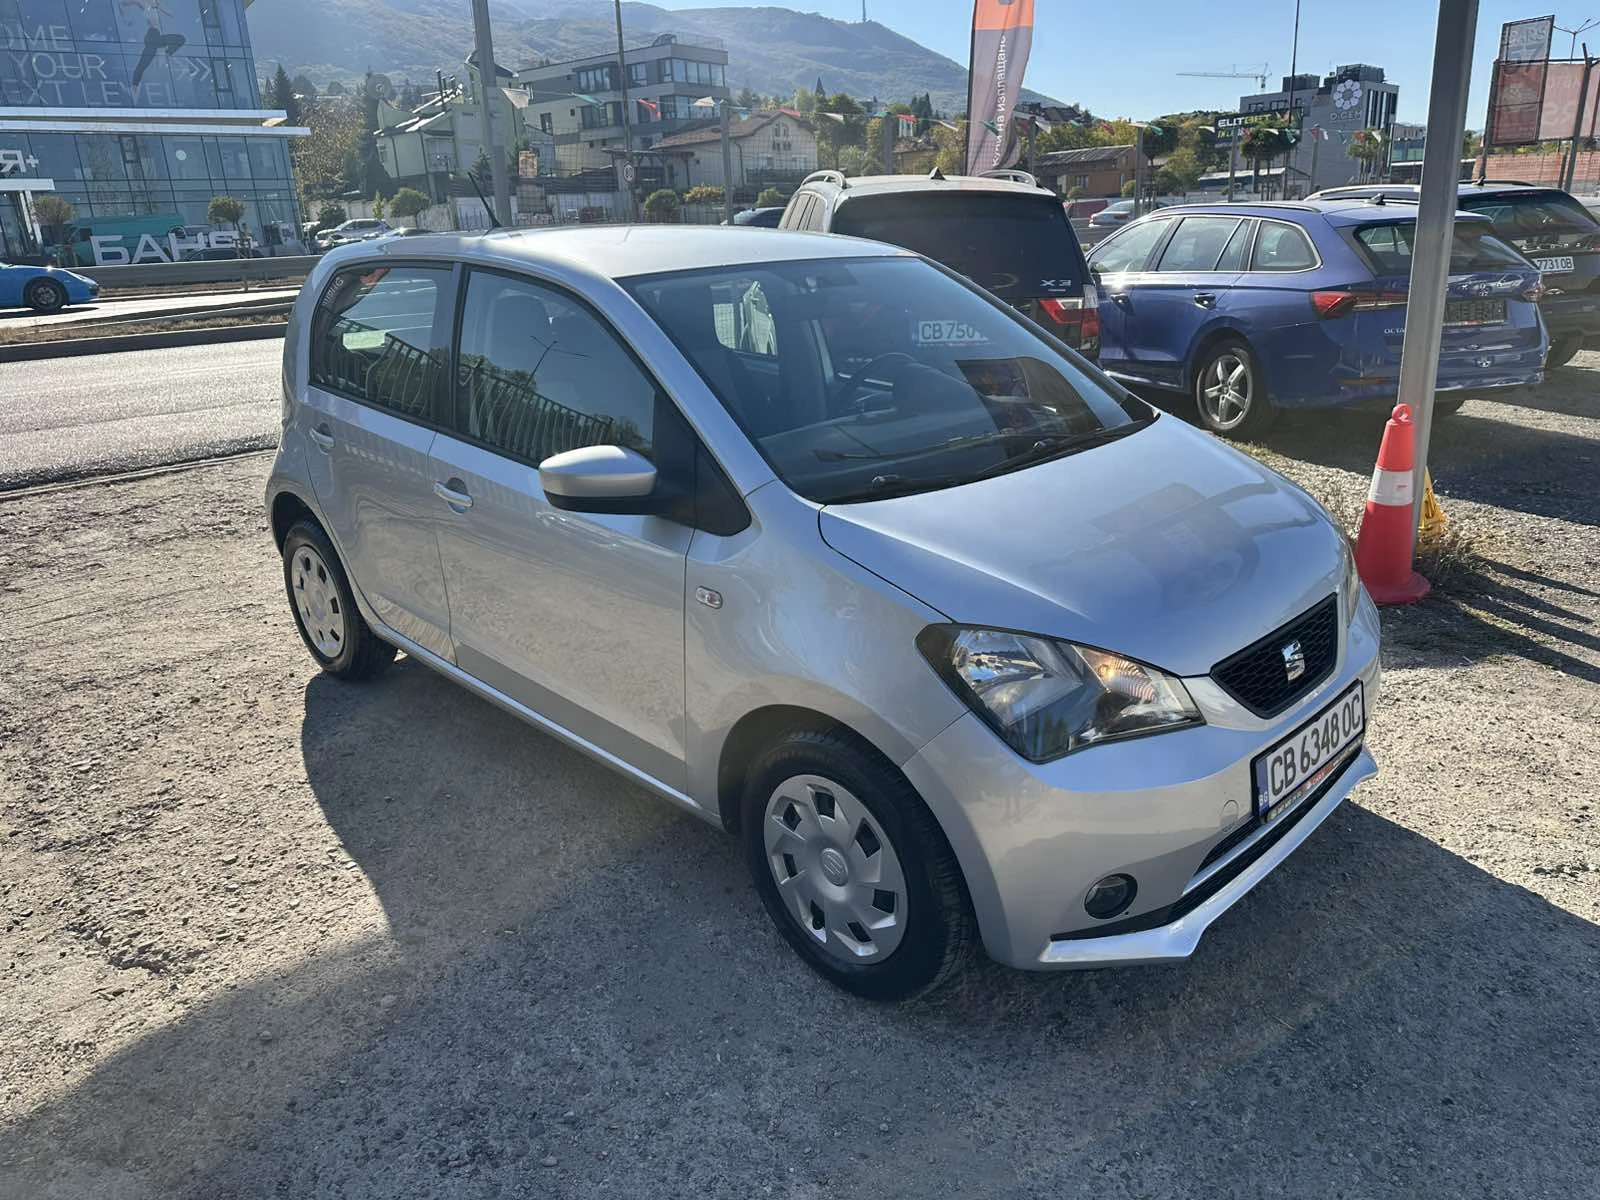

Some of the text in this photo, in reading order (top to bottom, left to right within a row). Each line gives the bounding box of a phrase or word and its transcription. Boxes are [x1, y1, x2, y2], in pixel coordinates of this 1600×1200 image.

[11, 52, 107, 79] YOUR
[2, 79, 184, 105] EXT LEVEL
[945, 323, 985, 340] 750
[1271, 747, 1297, 796] CB
[1300, 712, 1340, 774] 6348
[1342, 695, 1360, 735] OC
